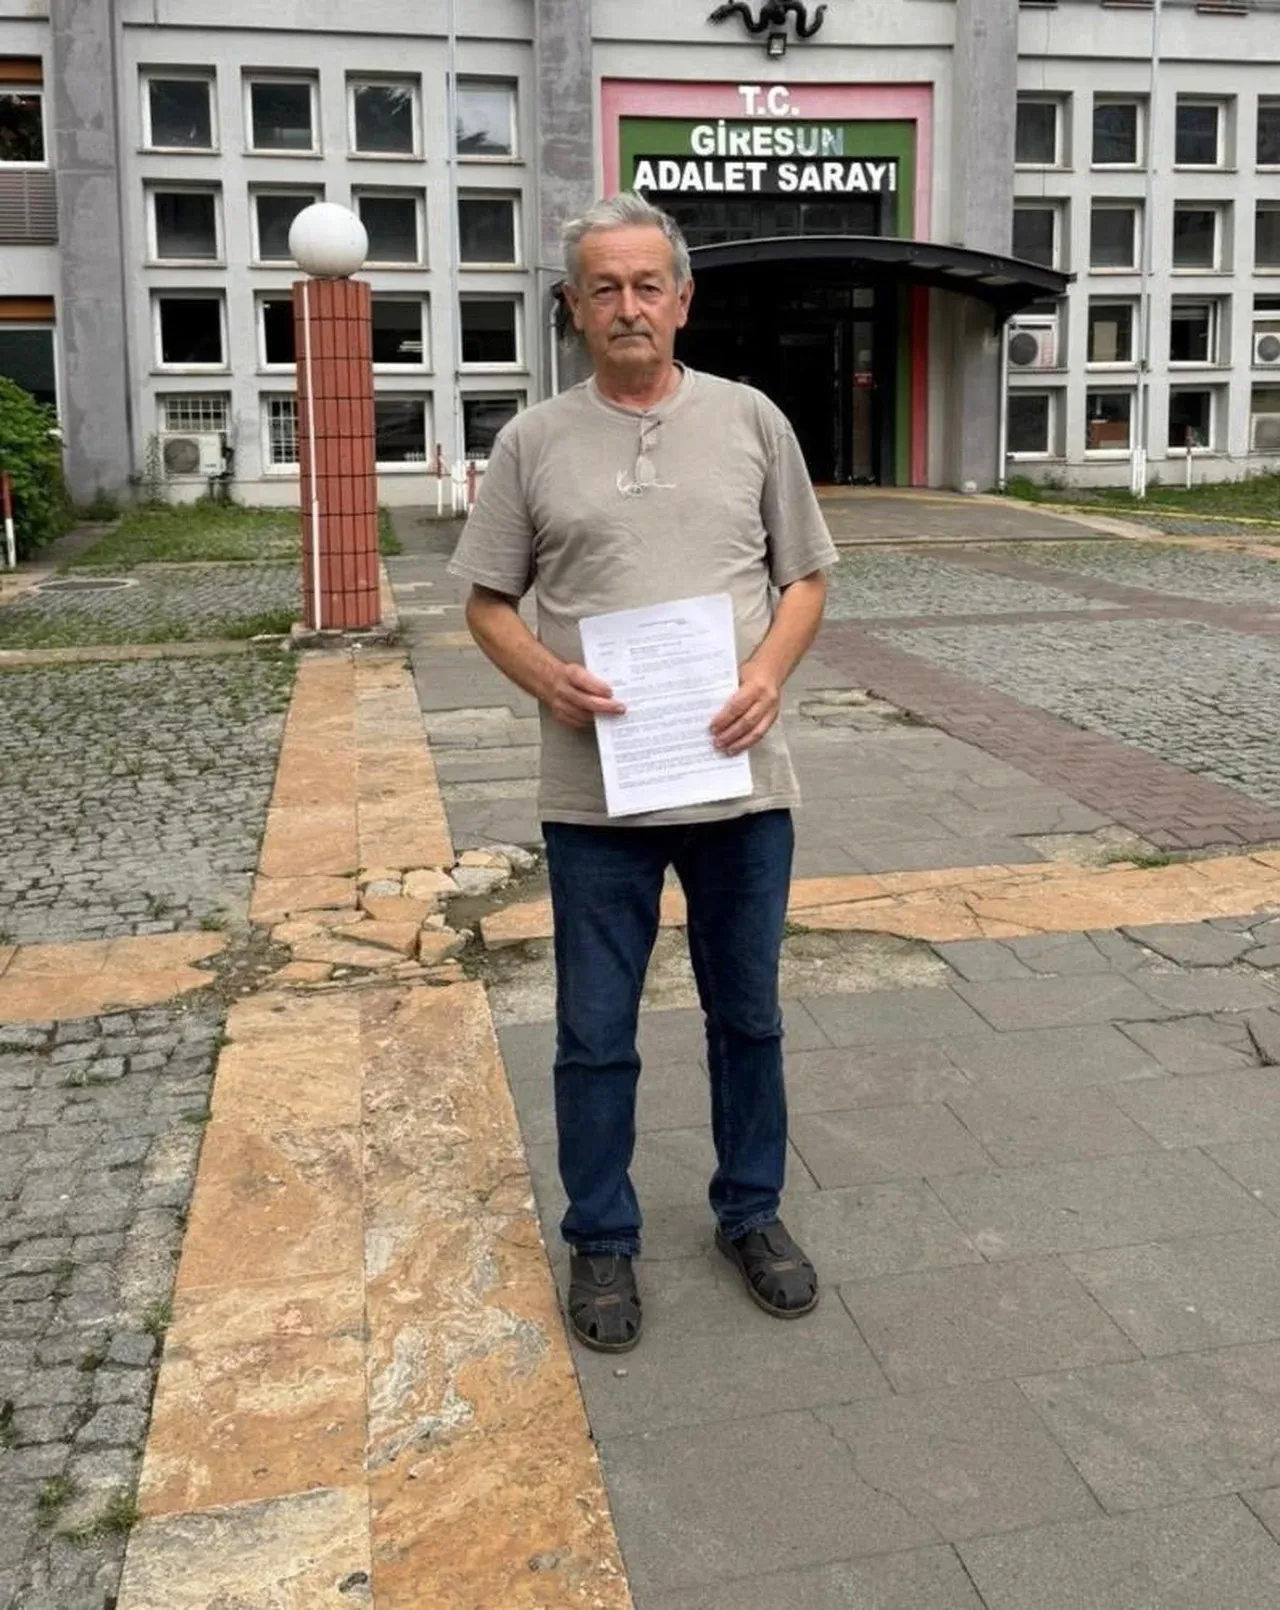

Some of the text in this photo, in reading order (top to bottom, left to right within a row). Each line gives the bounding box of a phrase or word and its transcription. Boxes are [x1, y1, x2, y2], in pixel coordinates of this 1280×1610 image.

[738, 86, 800, 116] T.C.
[690, 120, 844, 156] GİRESUN
[633, 162, 896, 192] ADALET SARAYI
